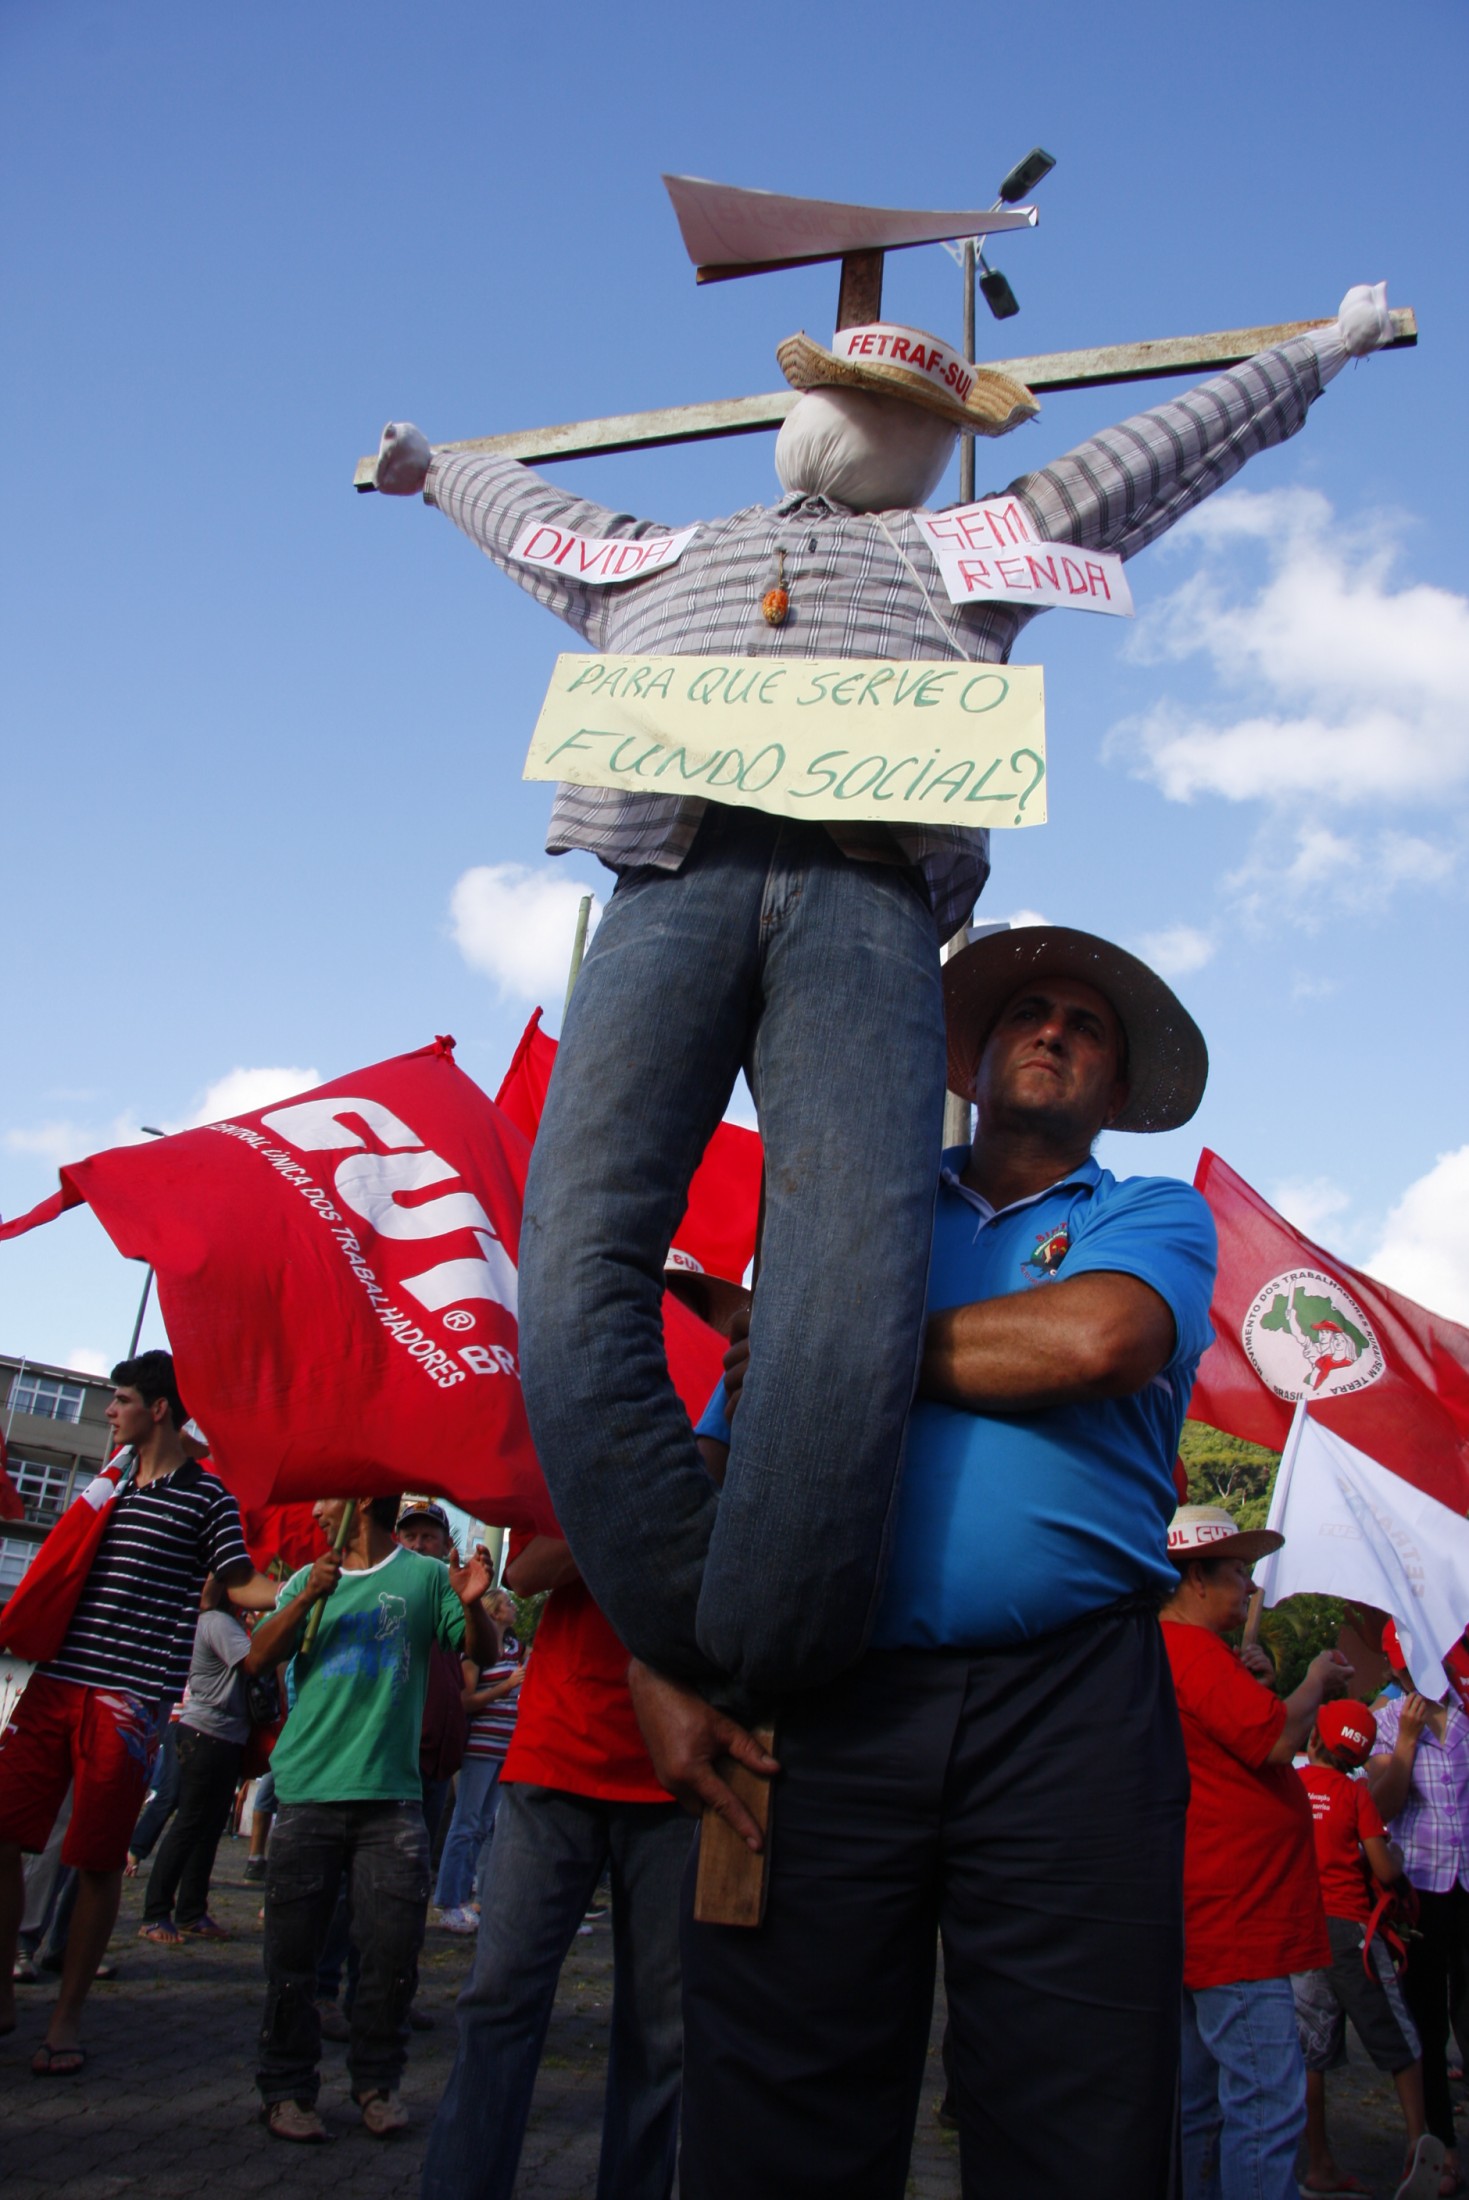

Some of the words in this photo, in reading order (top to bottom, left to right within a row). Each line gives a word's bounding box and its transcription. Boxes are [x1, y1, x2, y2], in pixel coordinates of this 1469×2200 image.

[847, 333, 973, 401] FETRAF-SUL
[926, 502, 1031, 550] SEM
[523, 527, 675, 575] DIVIDA
[957, 554, 1112, 600] RENDA
[566, 663, 675, 700] PARA
[687, 666, 788, 705] QUE
[796, 667, 959, 708] SERVE
[960, 673, 1010, 714] O
[544, 728, 787, 793] FUNDO
[261, 1097, 519, 1322] CUT
[204, 1123, 272, 1149] CENTRAL
[261, 1149, 314, 1187] ÚNICA
[300, 1188, 344, 1222] DOS
[331, 1226, 467, 1389] TRABALHADORES
[1259, 1281, 1281, 1302] DOS
[1282, 1271, 1369, 1328] TRABALHADORES
[457, 1344, 521, 1381] BR
[1244, 1304, 1263, 1377] MOVIMENTO
[1273, 1385, 1304, 1401] BRASIL
[1330, 1377, 1369, 1395] TERRA
[1367, 1360, 1383, 1378] SEM
[1340, 1726, 1368, 1748] MST
